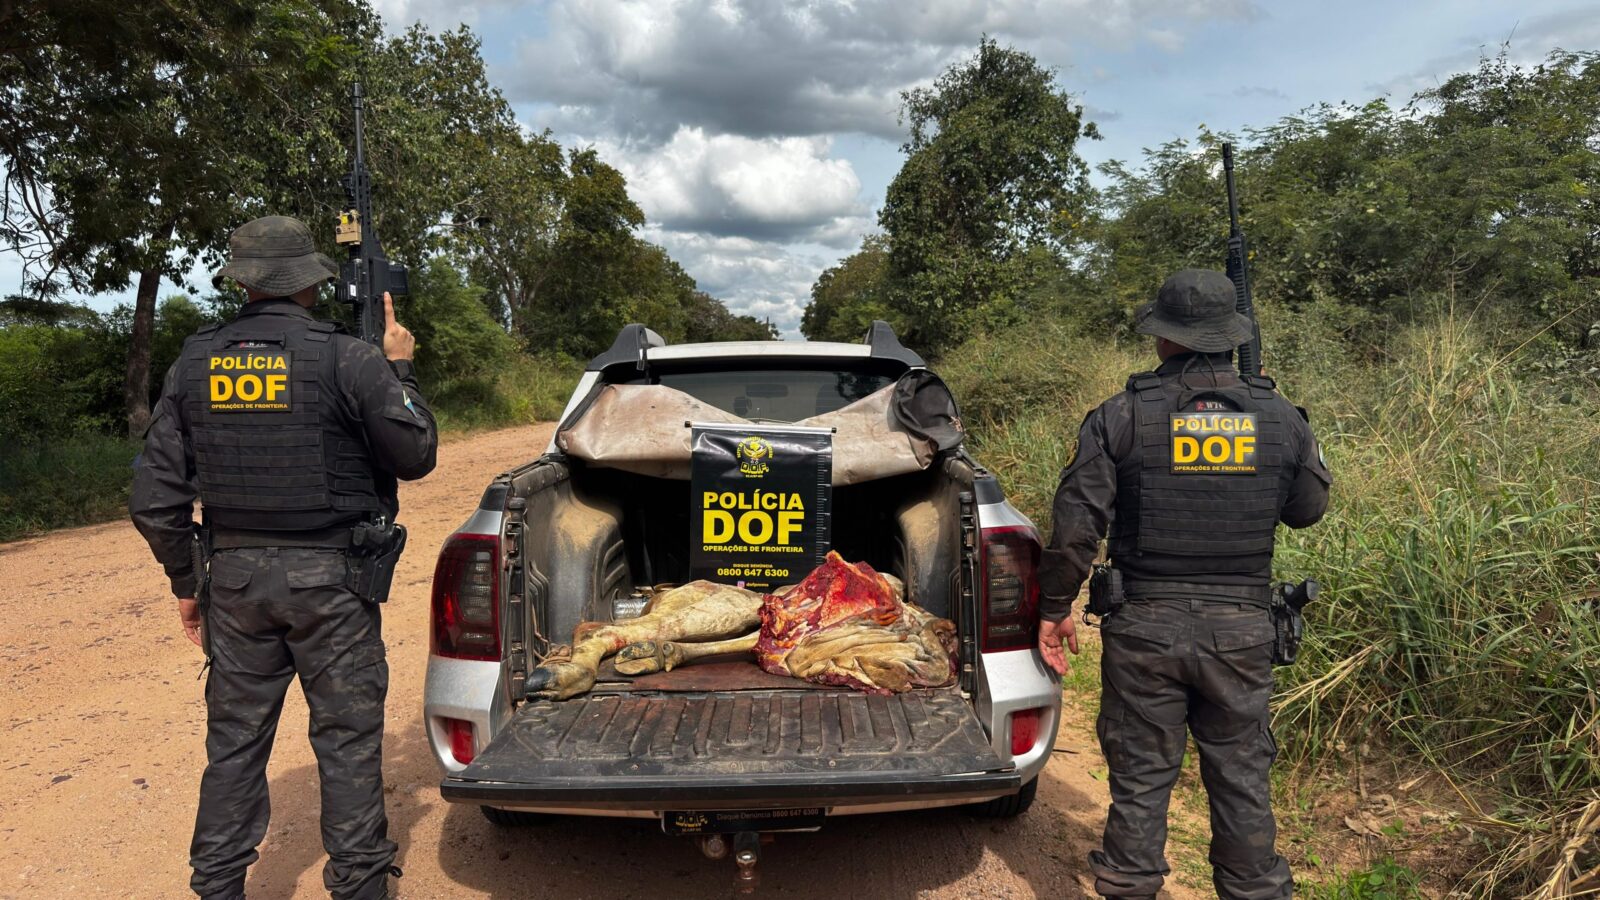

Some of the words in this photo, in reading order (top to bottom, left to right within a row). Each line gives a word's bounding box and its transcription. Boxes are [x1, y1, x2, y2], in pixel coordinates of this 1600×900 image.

[210, 353, 287, 370] POLÍCIA
[210, 374, 287, 402] DOF
[1173, 415, 1255, 432] POLÍCIA
[1173, 436, 1256, 463] DOF
[703, 489, 804, 510] POLÍCIA
[703, 510, 805, 545] DOF
[703, 545, 748, 553] OPERAÇÕES
[717, 568, 742, 576] 0800
[744, 568, 762, 577] 647
[764, 569, 789, 577] 6300
